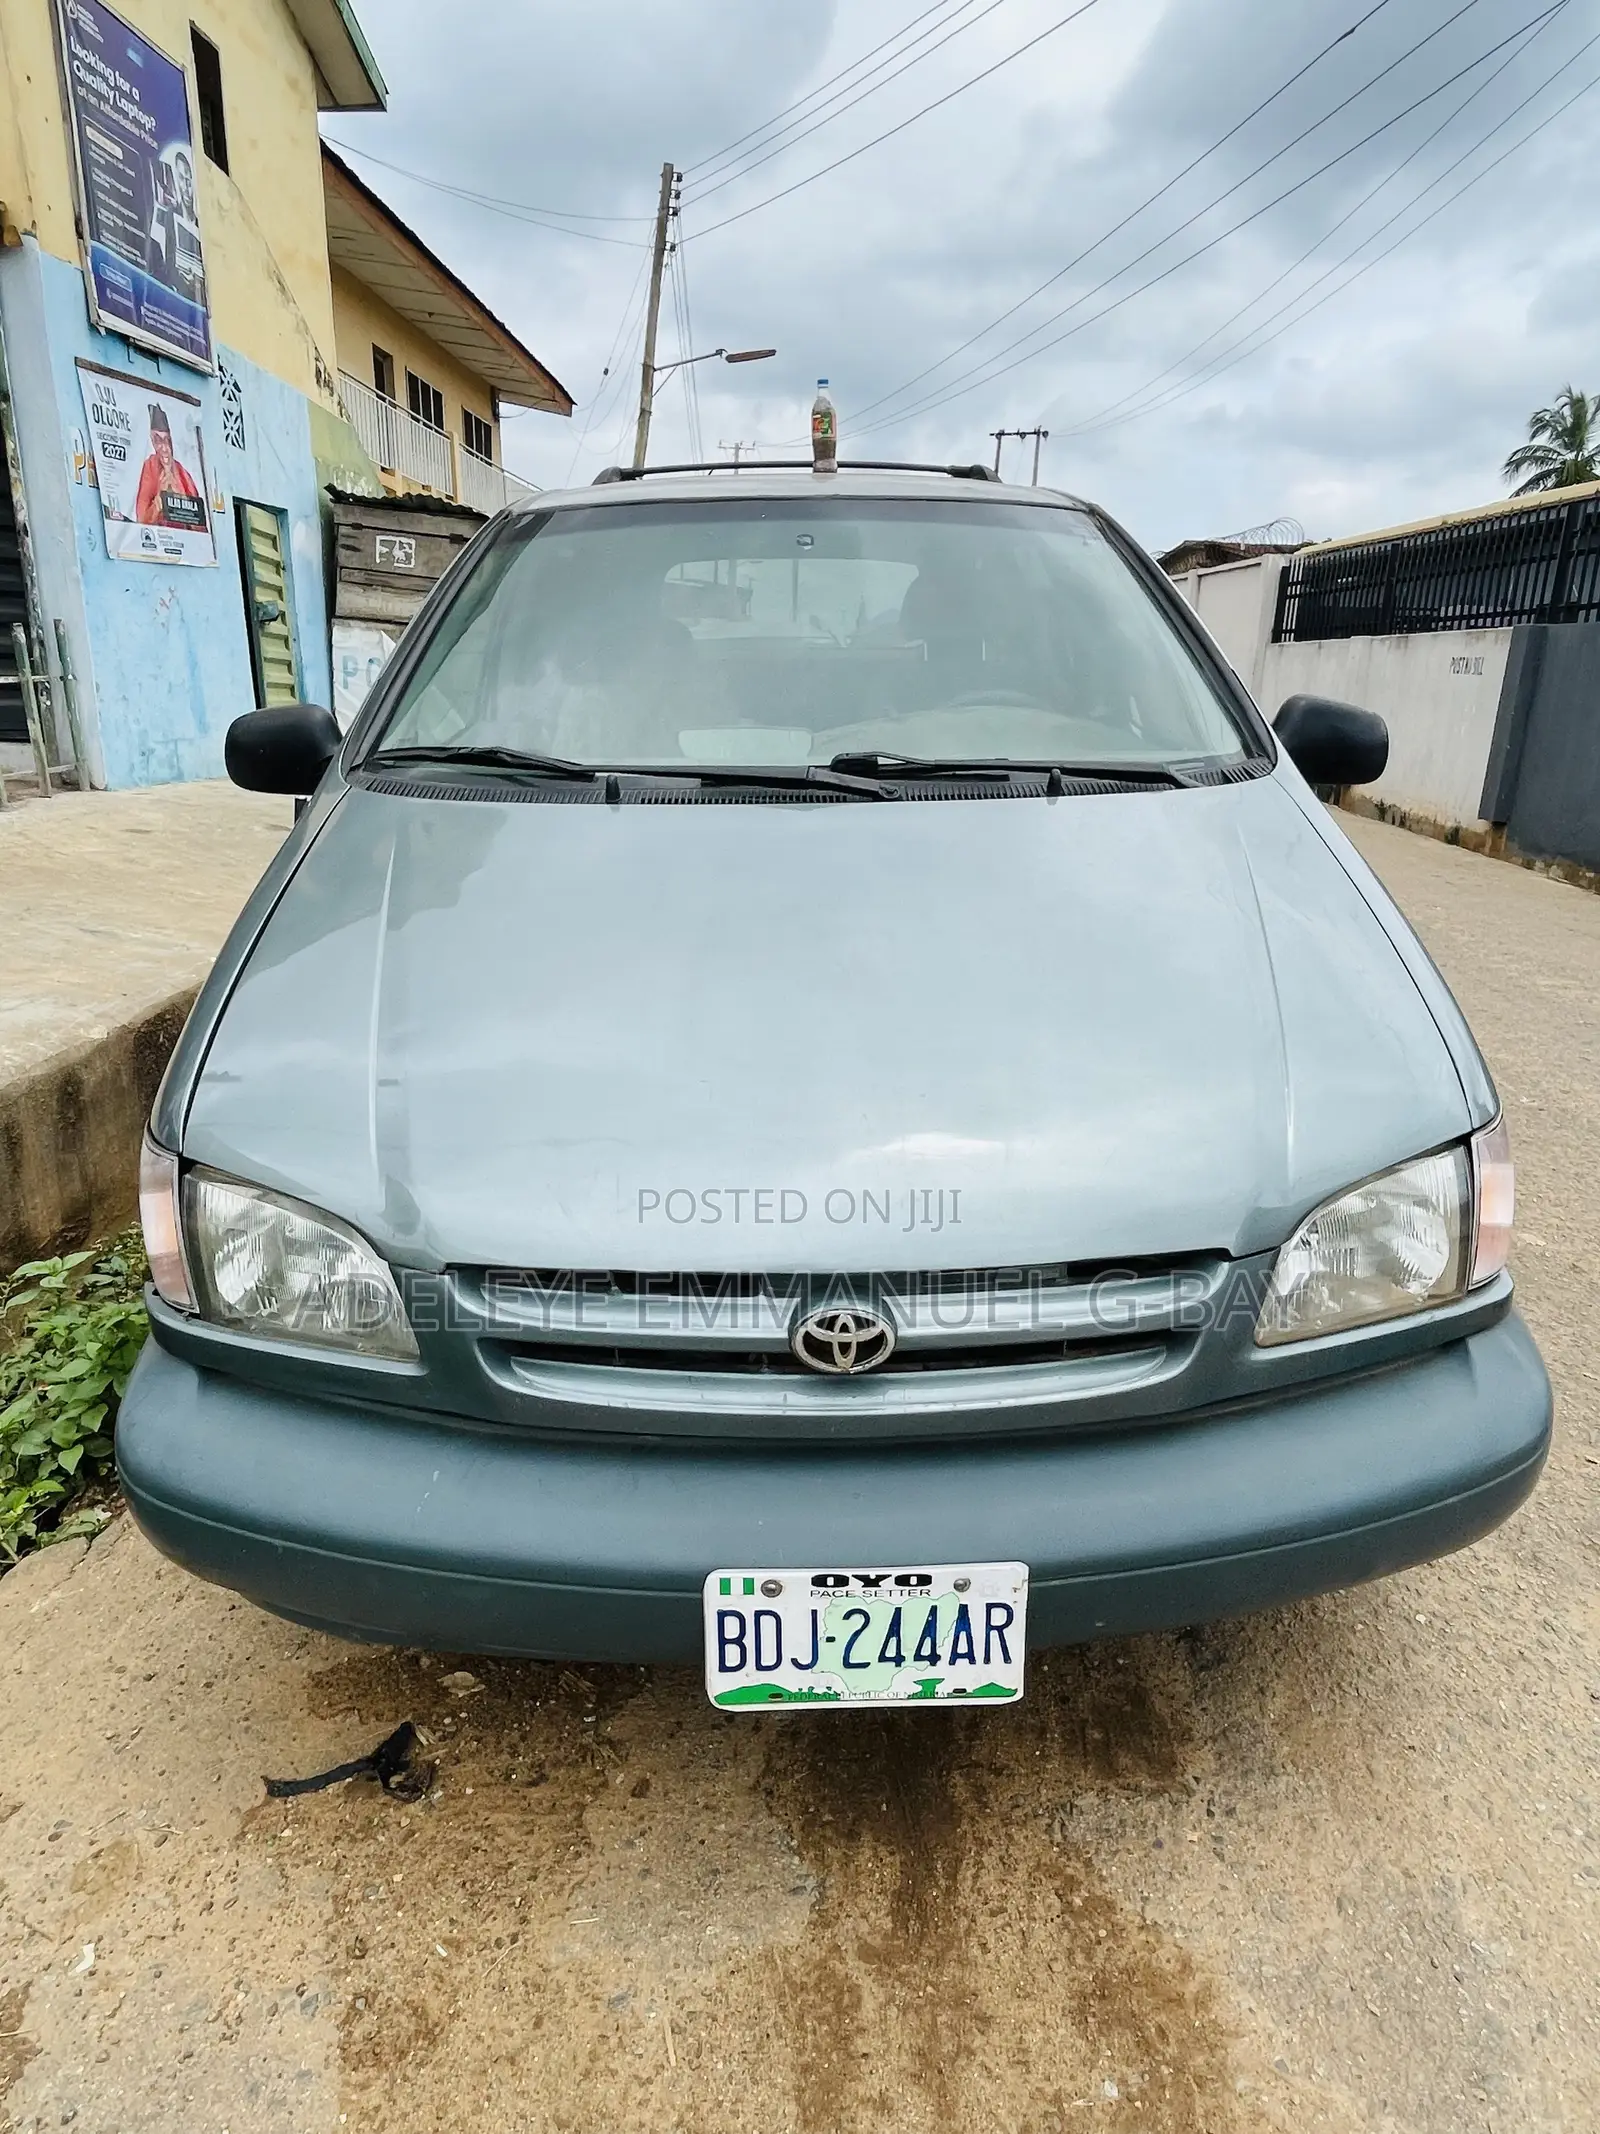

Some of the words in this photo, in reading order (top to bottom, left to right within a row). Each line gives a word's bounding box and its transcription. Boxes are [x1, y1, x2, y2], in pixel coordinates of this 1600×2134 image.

[69, 35, 115, 87] Looking
[115, 70, 131, 95] for
[132, 87, 140, 102] a
[73, 60, 115, 106] Quality
[115, 90, 157, 132] Laptop?
[103, 444, 125, 460] 2027
[810, 1589, 860, 1598] PACE
[862, 1588, 931, 1598] SETTER
[811, 1573, 933, 1588] OYO
[716, 1602, 1014, 1673] BDJ-244AR
